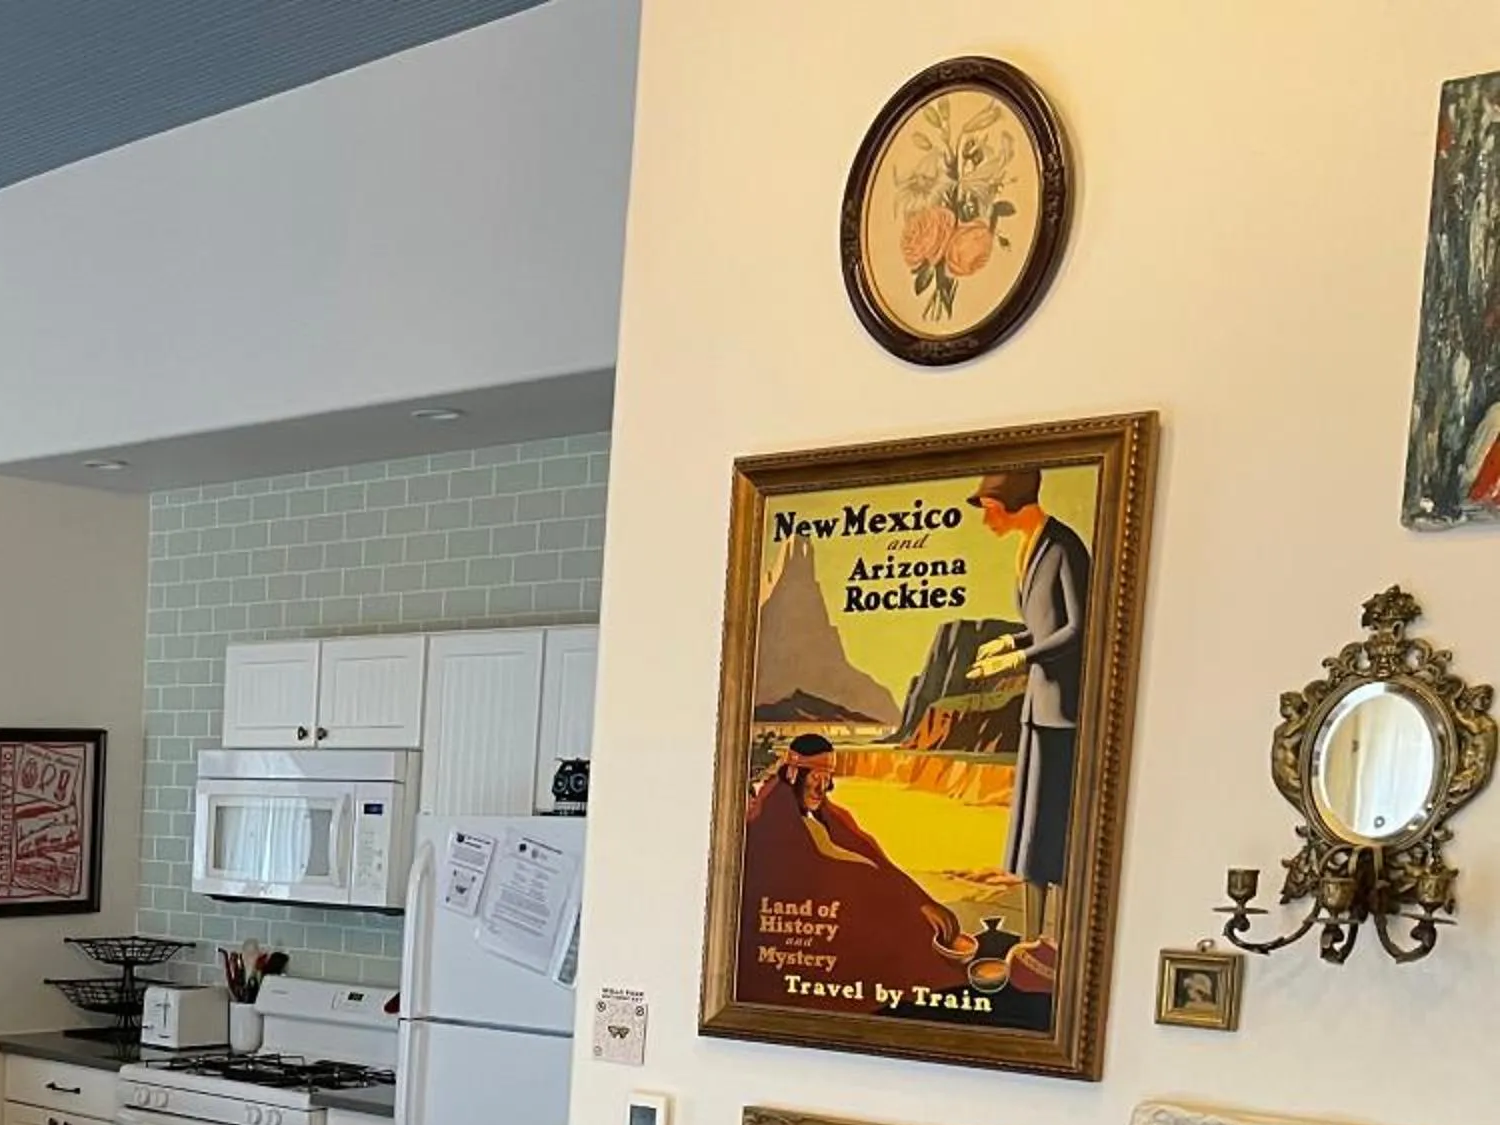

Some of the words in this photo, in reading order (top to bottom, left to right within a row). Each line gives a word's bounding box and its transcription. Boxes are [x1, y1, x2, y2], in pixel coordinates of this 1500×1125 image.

[774, 512, 839, 542] New
[841, 500, 962, 537] Mexico
[887, 534, 930, 551] and
[848, 555, 966, 581] Arizona
[844, 580, 966, 612] Rockies
[759, 897, 813, 917] Land
[817, 901, 840, 918] of
[759, 915, 840, 941] History
[785, 936, 813, 947] and
[758, 946, 837, 972] Mystery
[785, 975, 864, 999] Travel
[875, 983, 903, 1009] by
[912, 986, 993, 1012] Train
